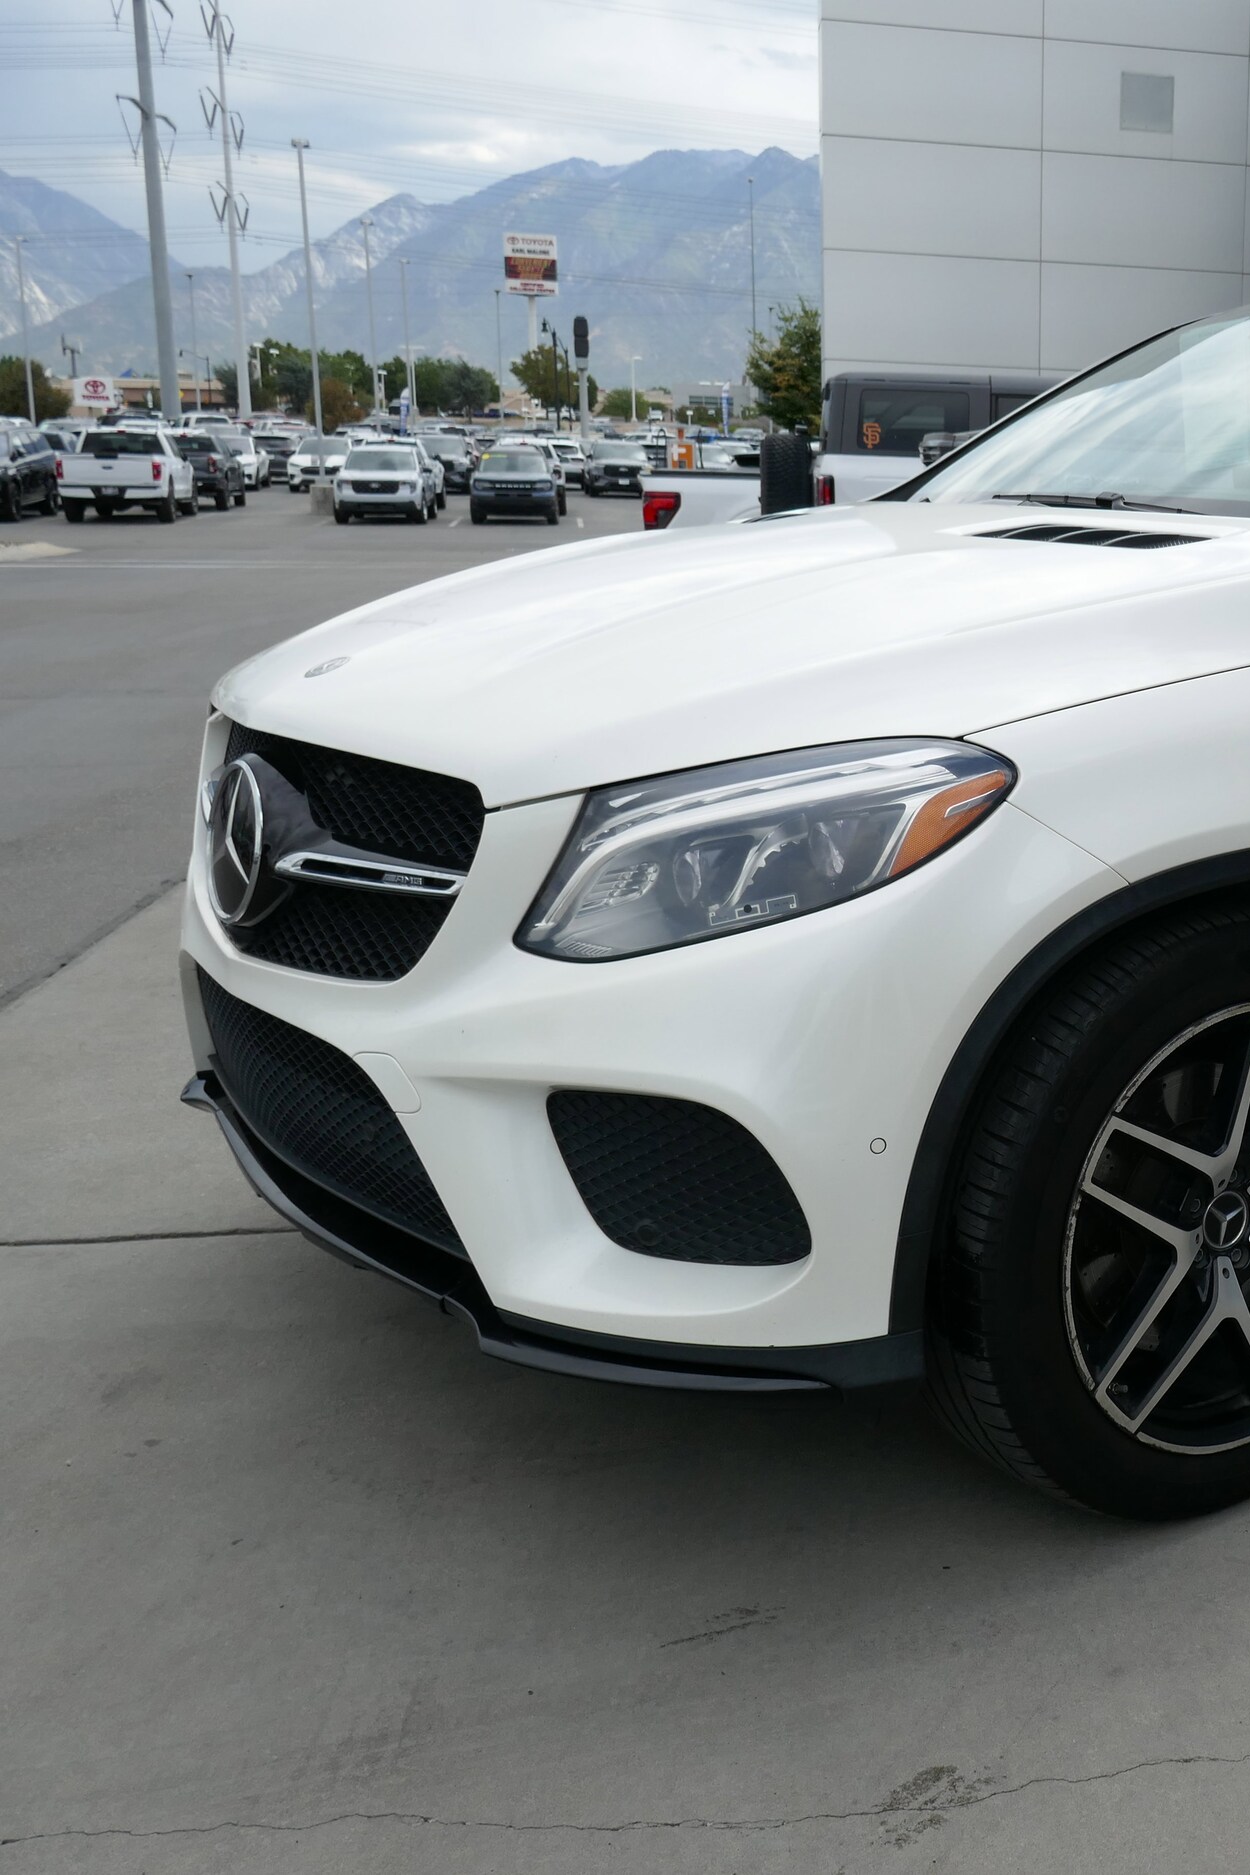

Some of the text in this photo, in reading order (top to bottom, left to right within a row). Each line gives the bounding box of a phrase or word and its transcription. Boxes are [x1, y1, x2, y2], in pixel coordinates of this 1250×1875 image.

[521, 238, 554, 247] TOYOTA
[863, 422, 881, 448] SF
[396, 875, 423, 886] AMG
